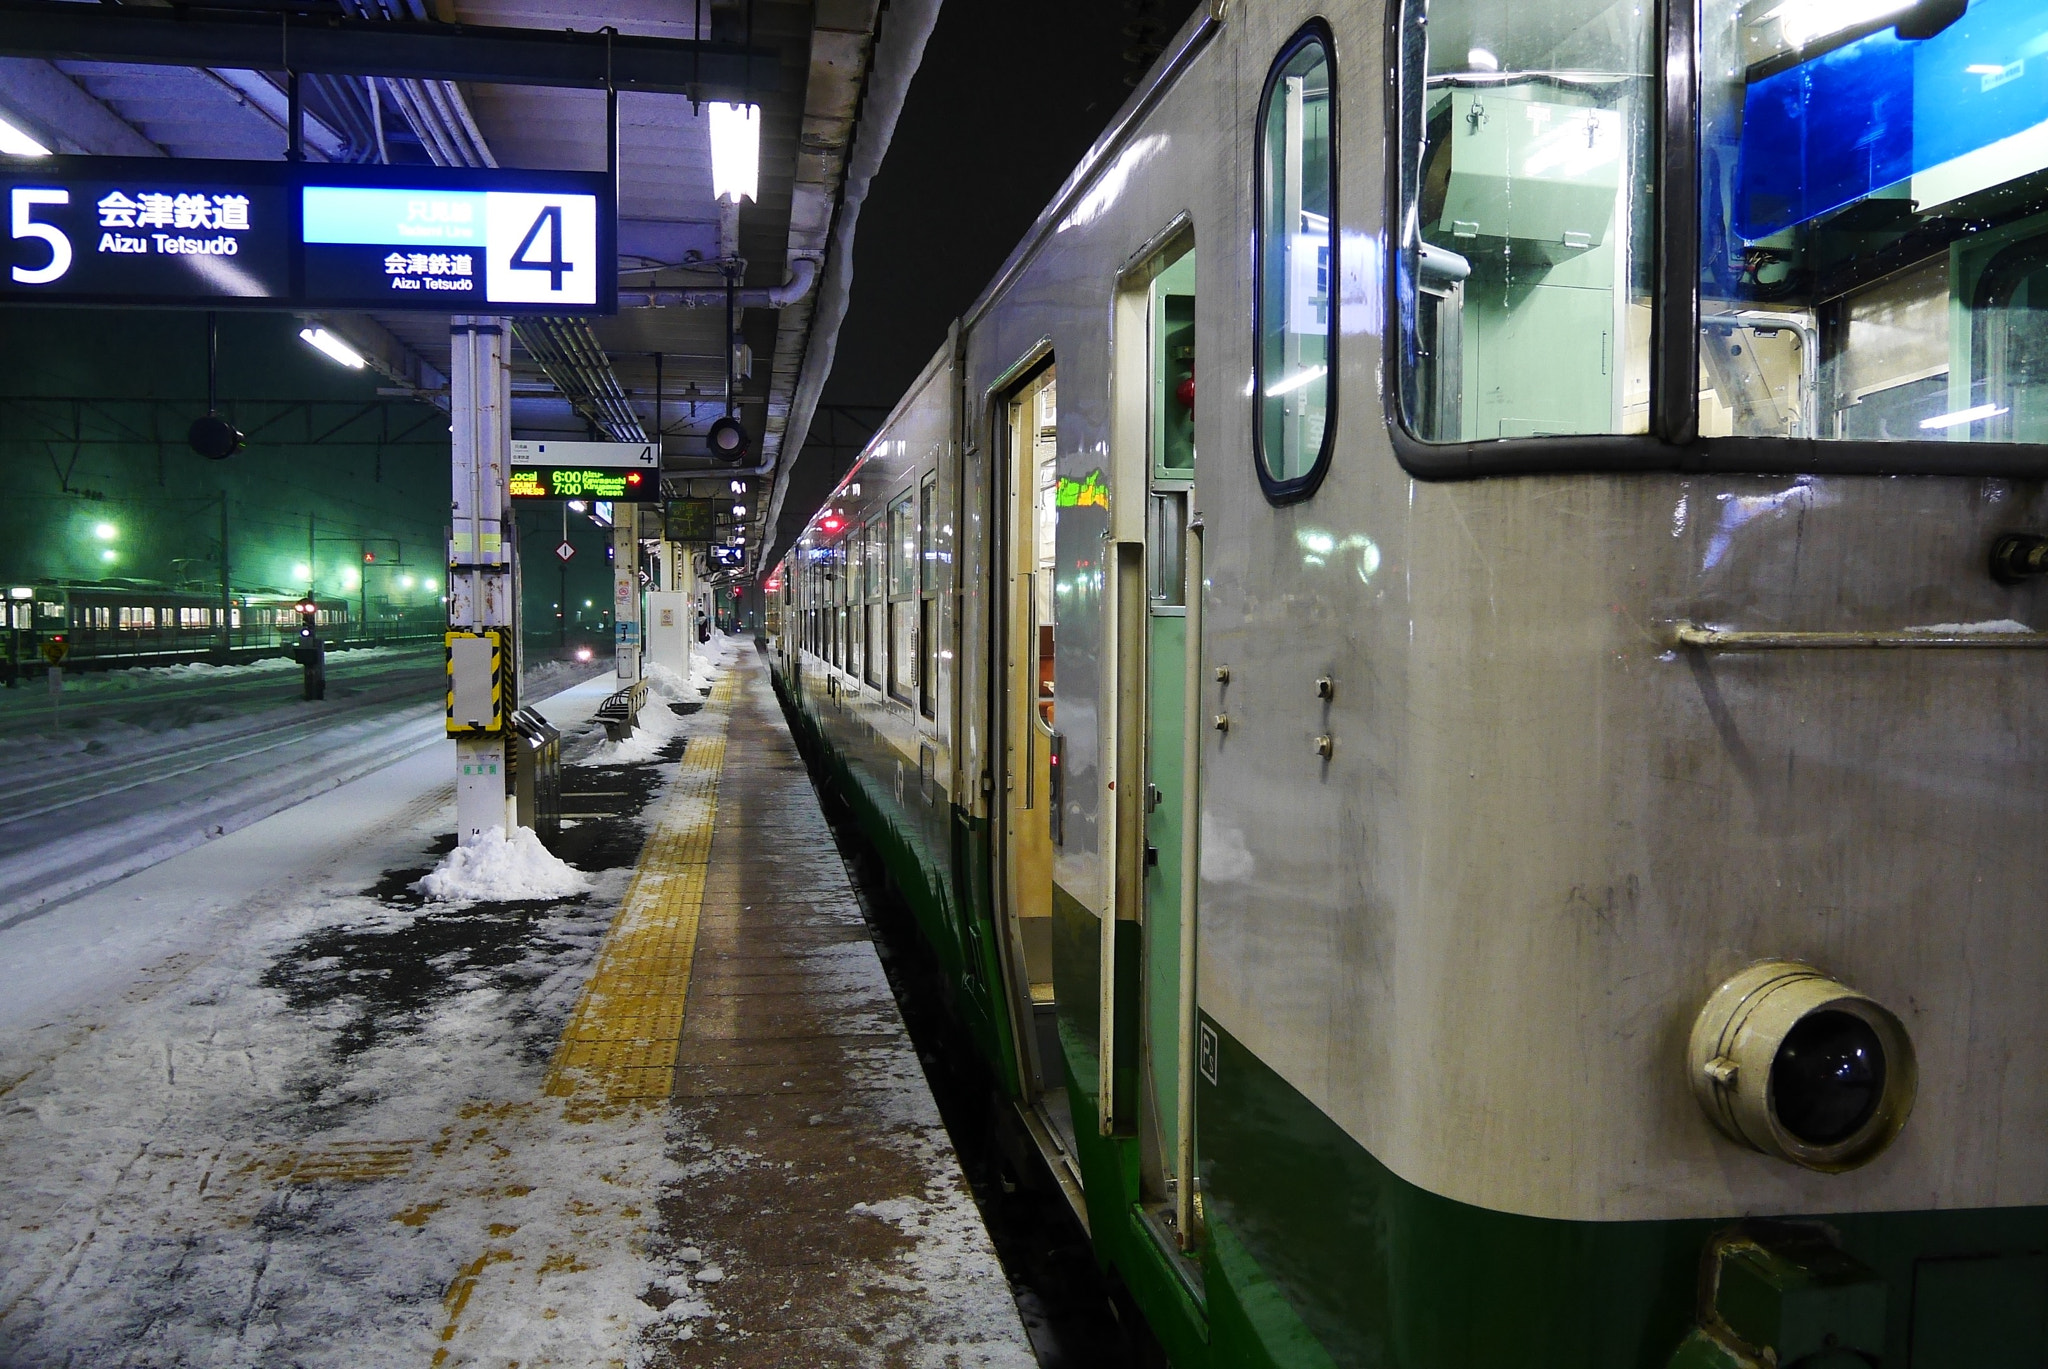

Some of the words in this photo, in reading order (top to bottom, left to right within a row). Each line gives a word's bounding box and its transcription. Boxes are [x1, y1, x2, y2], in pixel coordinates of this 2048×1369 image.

[97, 191, 250, 230] 会津鉄道
[11, 188, 73, 284] 5
[98, 232, 148, 253] Aizu
[151, 233, 239, 256] Tetsudō
[510, 206, 573, 291] 4
[384, 252, 473, 275] 会津鉄道
[391, 277, 420, 289] Aizu
[422, 277, 473, 290] Tetsudō
[640, 446, 653, 464] 4
[553, 471, 581, 482] 6:00
[553, 482, 581, 495] 7:00
